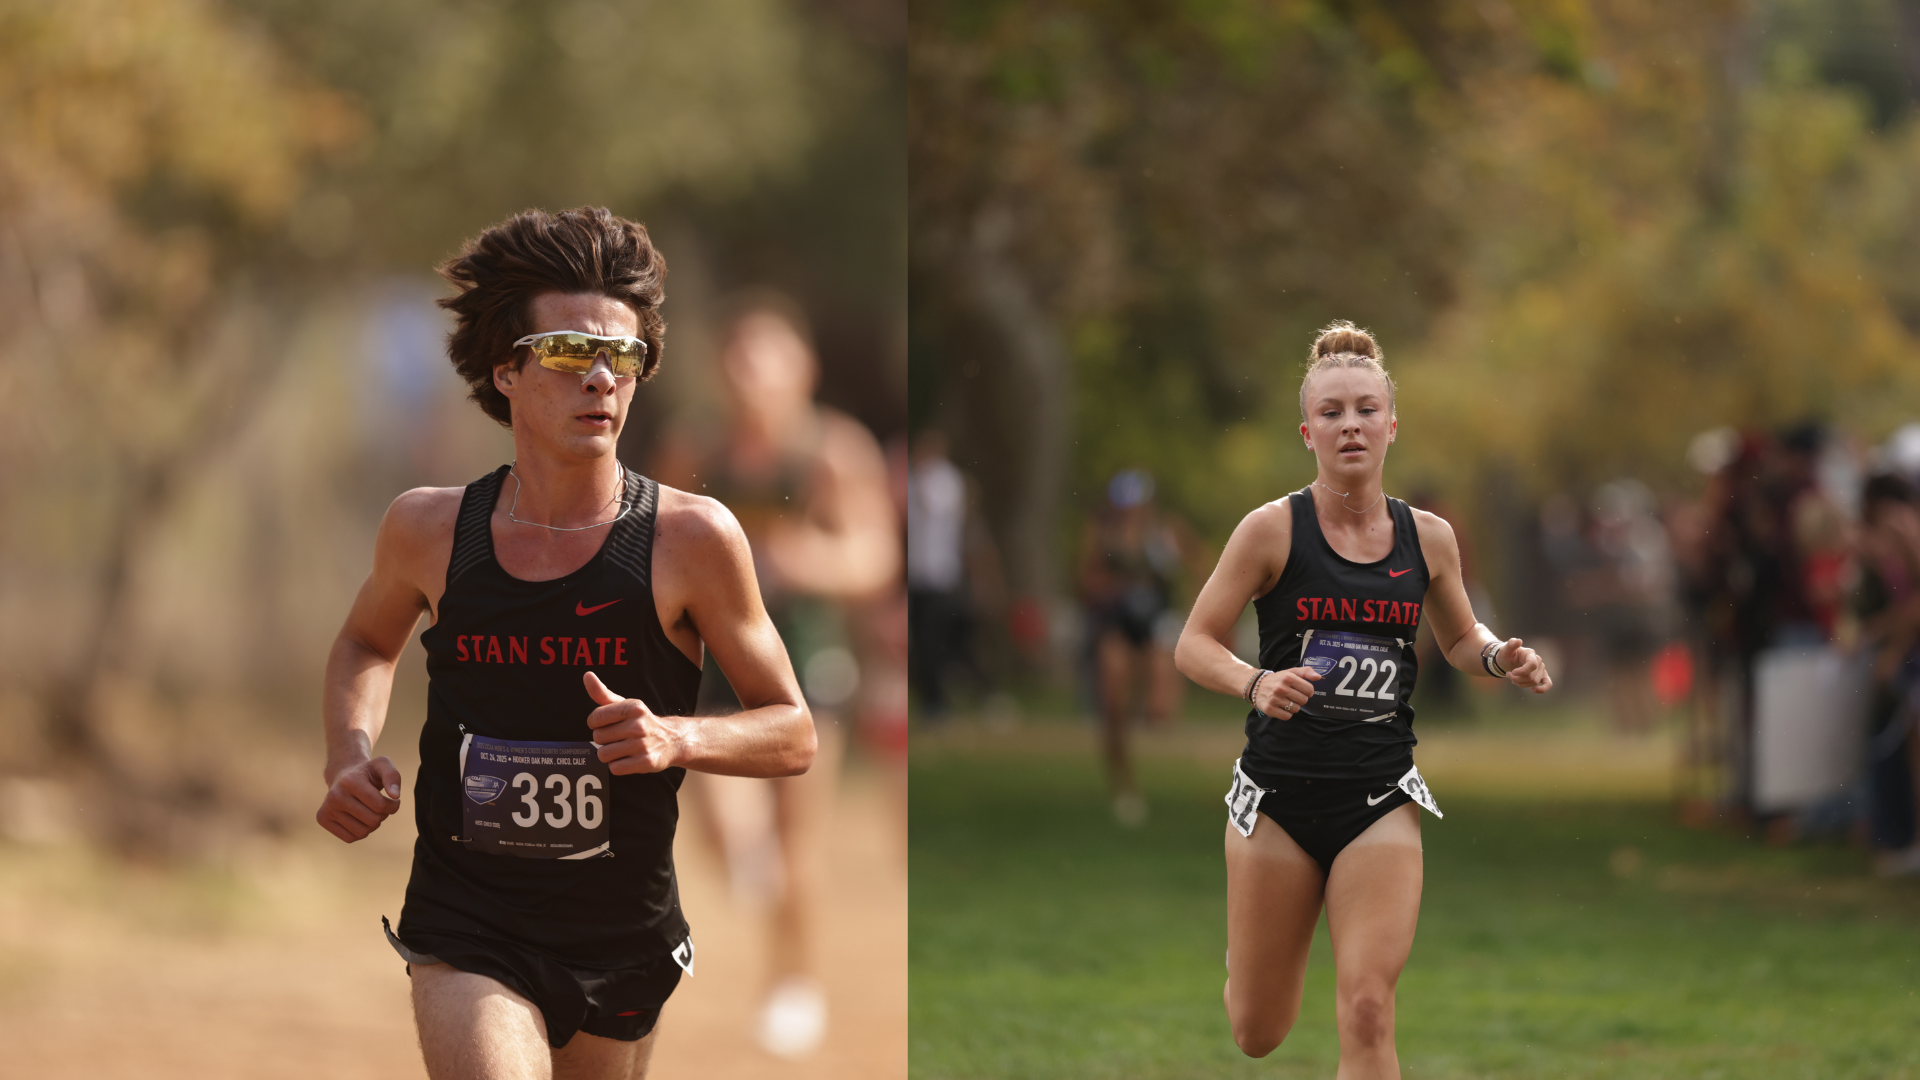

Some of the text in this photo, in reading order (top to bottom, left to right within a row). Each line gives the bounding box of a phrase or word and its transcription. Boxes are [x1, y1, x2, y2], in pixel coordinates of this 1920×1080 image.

[1296, 597, 1420, 626] STAN STATE
[456, 635, 629, 666] STAN STATE
[1334, 655, 1398, 701] 222
[531, 756, 541, 765] OAK
[511, 771, 604, 830] 336
